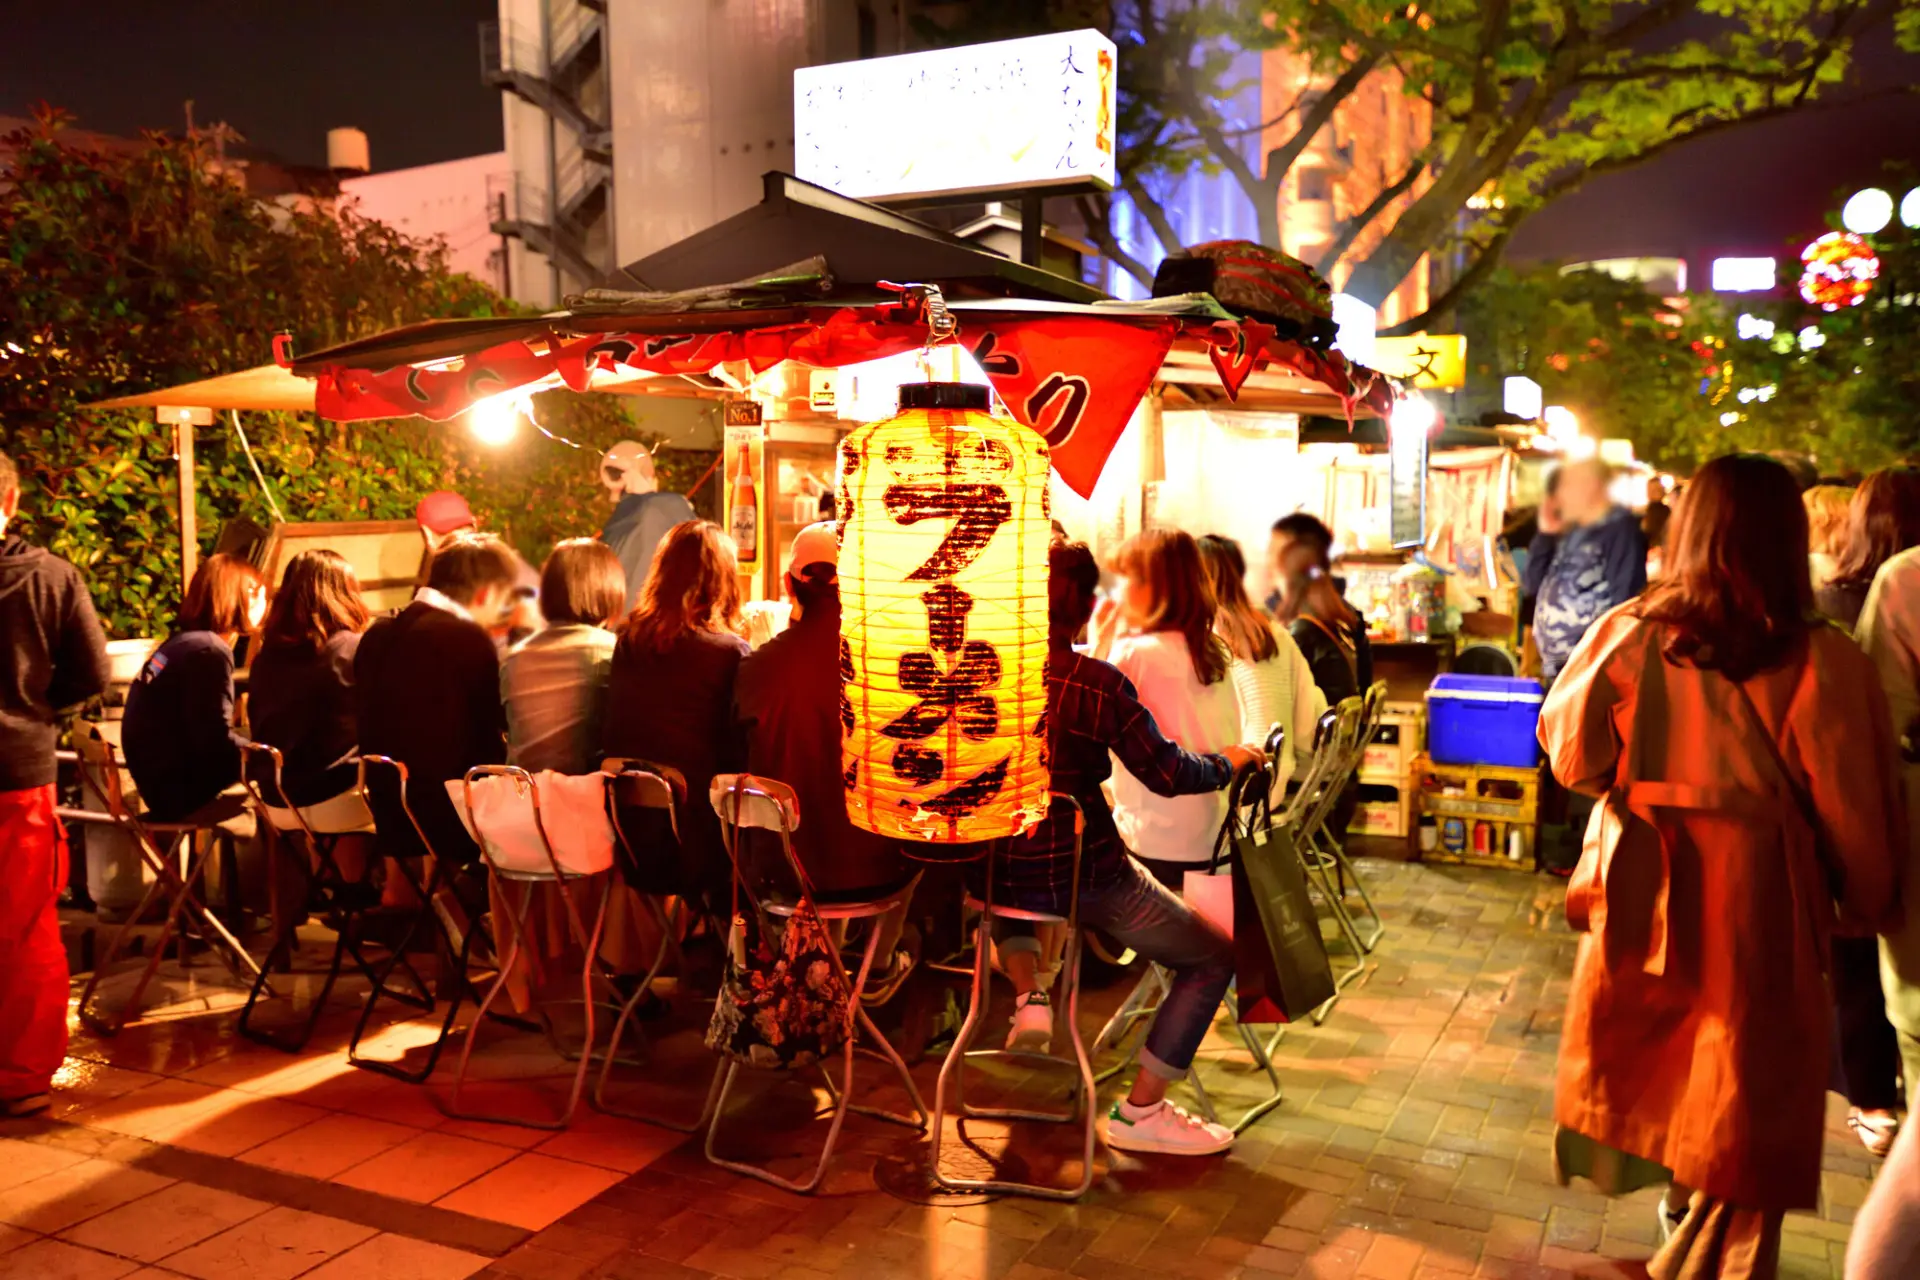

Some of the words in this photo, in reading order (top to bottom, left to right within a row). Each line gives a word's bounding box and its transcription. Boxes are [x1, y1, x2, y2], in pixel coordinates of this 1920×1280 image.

[1405, 346, 1441, 381] 文
[730, 408, 759, 422] No.1
[875, 438, 1014, 820] ラーメン
